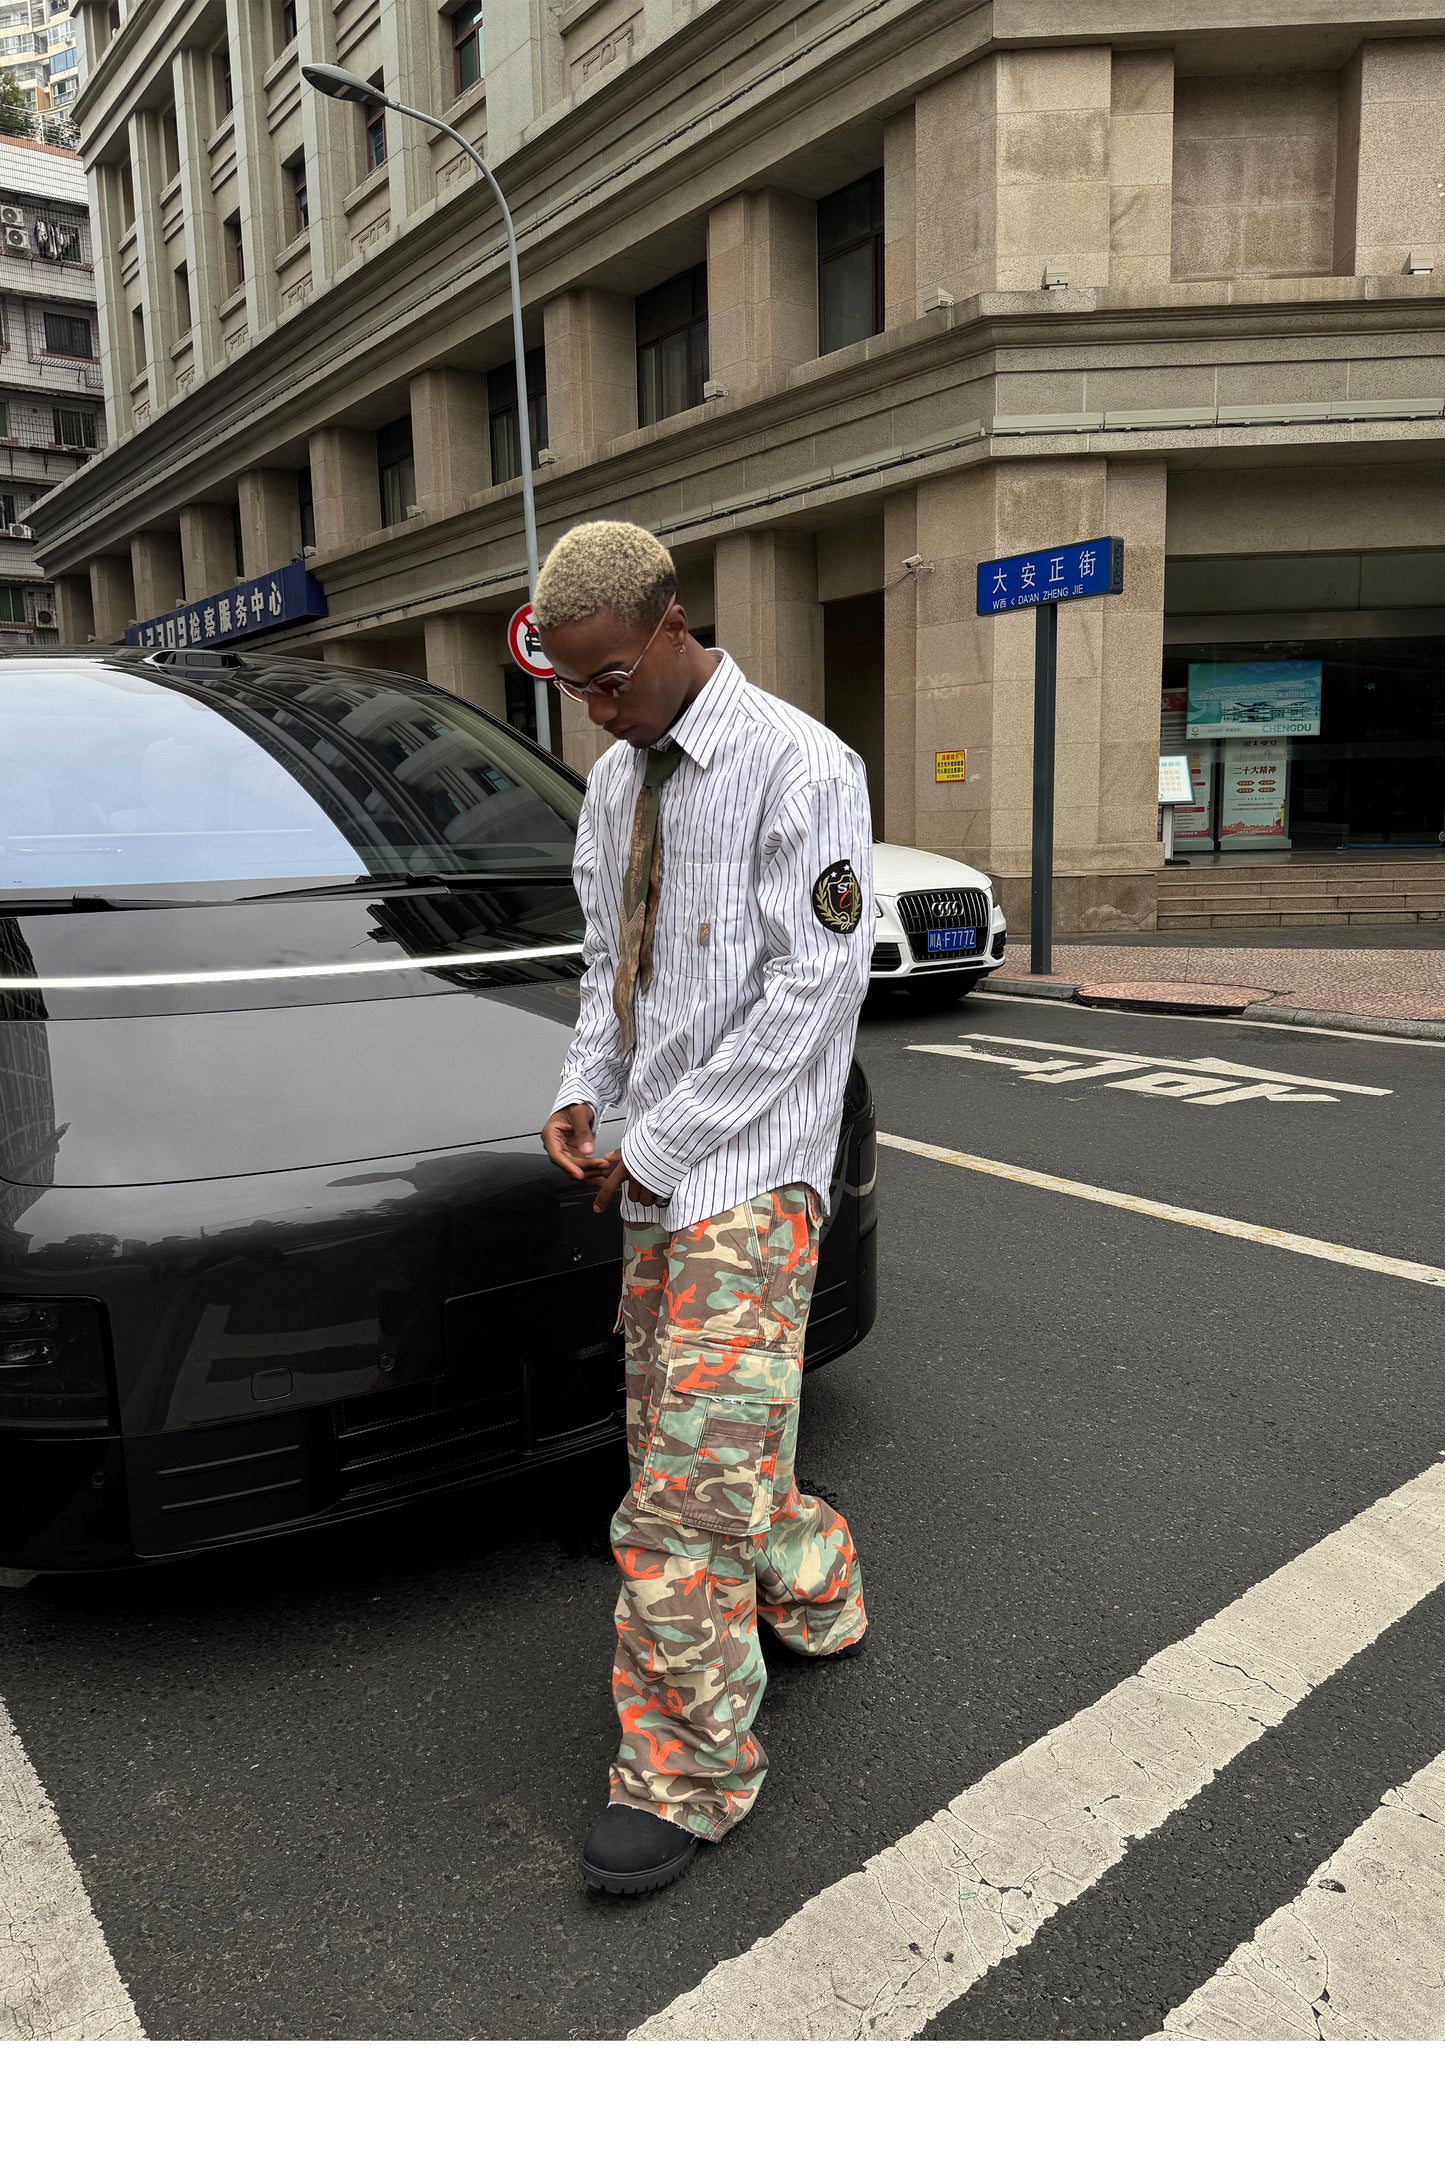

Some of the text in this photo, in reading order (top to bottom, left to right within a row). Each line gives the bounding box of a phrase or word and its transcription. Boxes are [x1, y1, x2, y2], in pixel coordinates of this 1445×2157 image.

[992, 550, 1096, 594] 大安正街
[1018, 592, 1040, 605] DA'AN
[1042, 586, 1069, 601] ZHENG
[1072, 583, 1084, 596] JIE
[1262, 723, 1312, 733] CHENGDU
[1232, 765, 1278, 775] 二十大精神
